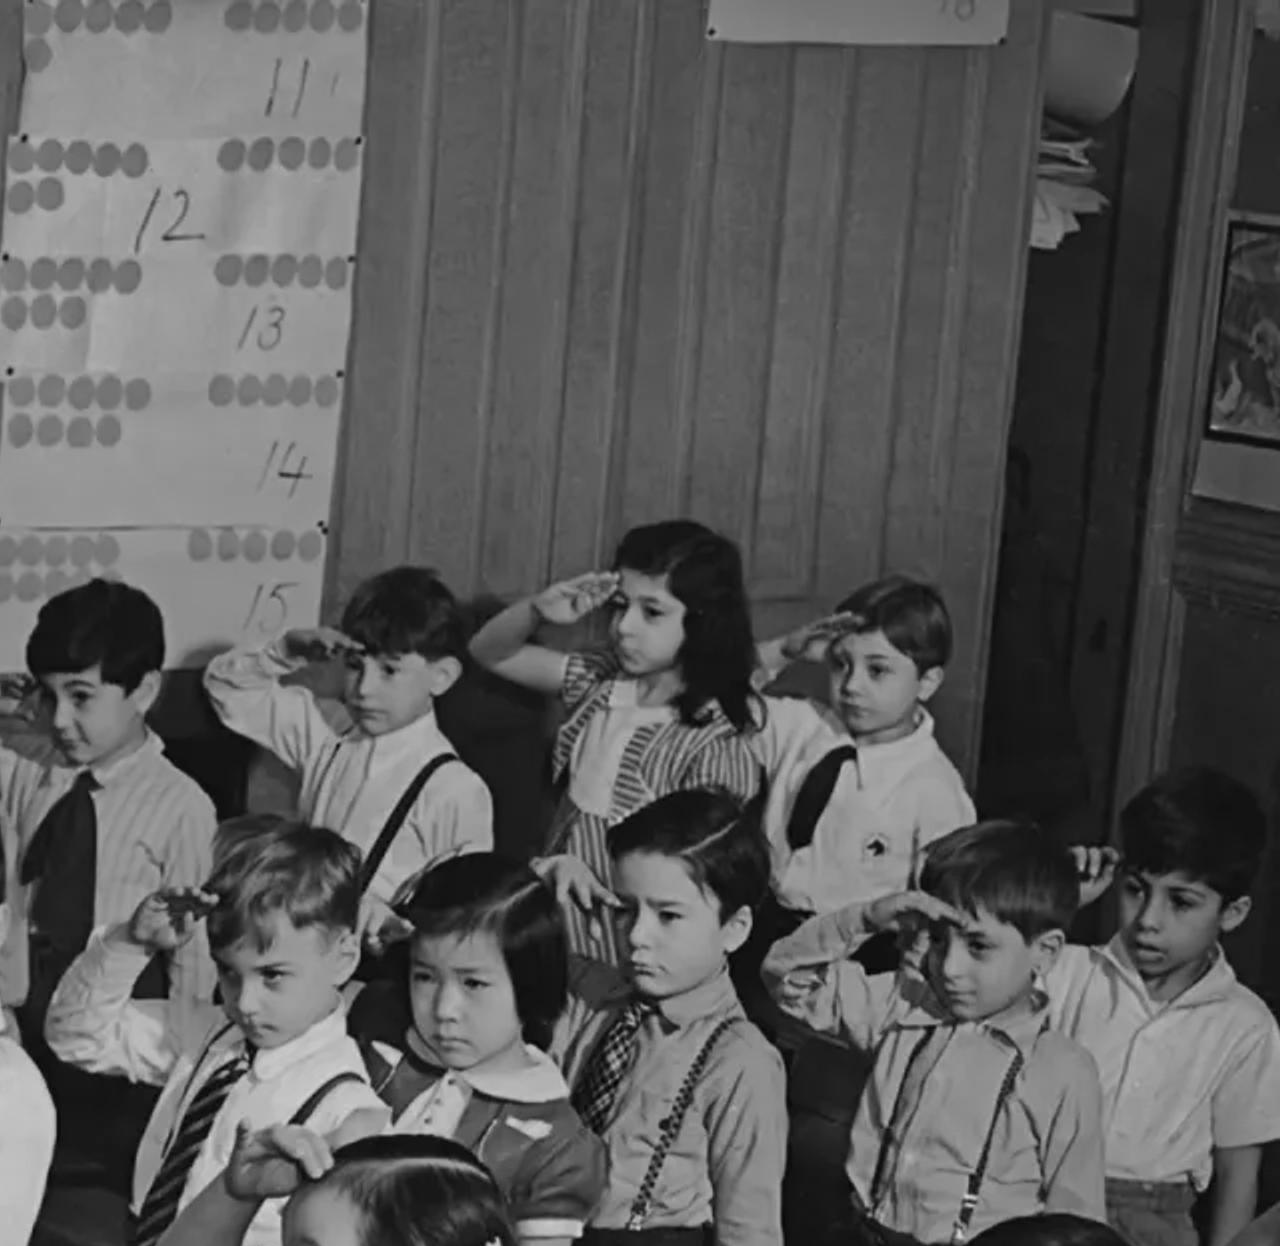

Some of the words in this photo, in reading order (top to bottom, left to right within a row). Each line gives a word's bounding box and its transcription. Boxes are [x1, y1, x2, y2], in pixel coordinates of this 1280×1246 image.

[135, 187, 206, 253] 12
[238, 305, 286, 351] 13
[257, 440, 313, 498] 14
[244, 583, 301, 630] 15
